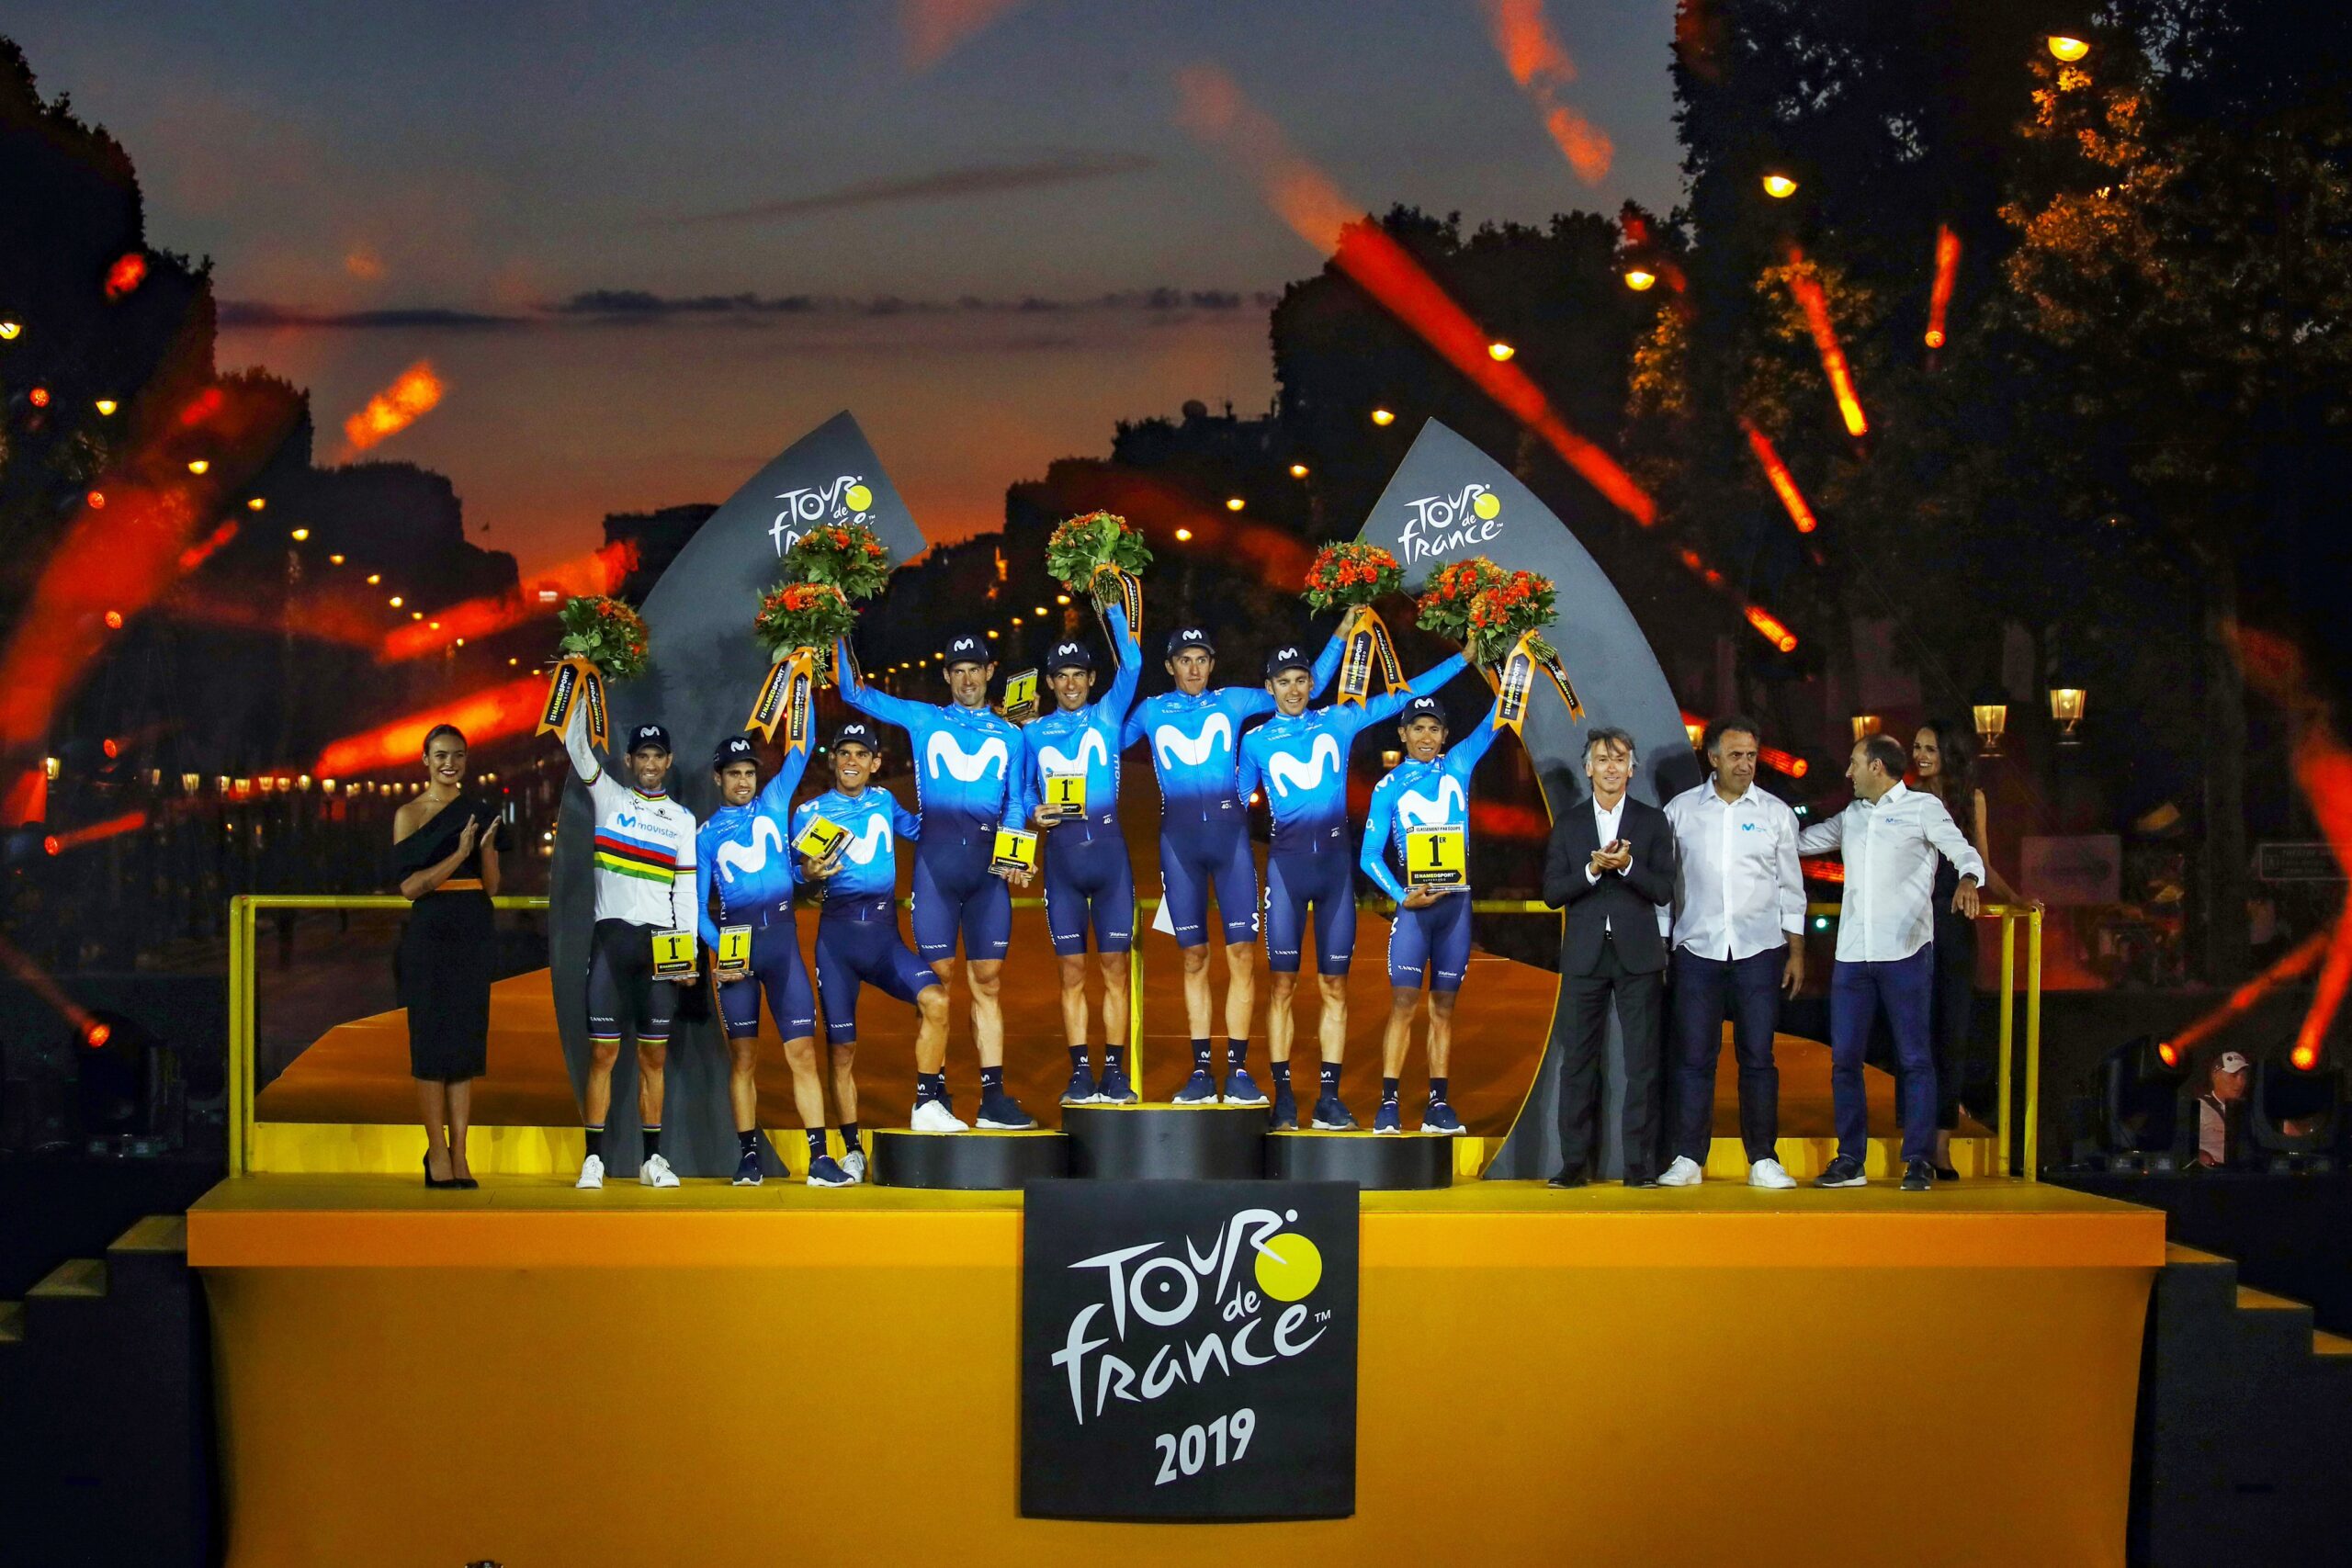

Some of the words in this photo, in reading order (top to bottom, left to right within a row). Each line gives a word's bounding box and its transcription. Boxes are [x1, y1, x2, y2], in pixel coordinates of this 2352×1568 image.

[833, 503, 849, 519] de
[1462, 512, 1476, 526] de
[1223, 1280, 1261, 1322] de
[1154, 1407, 1256, 1486] 2019
